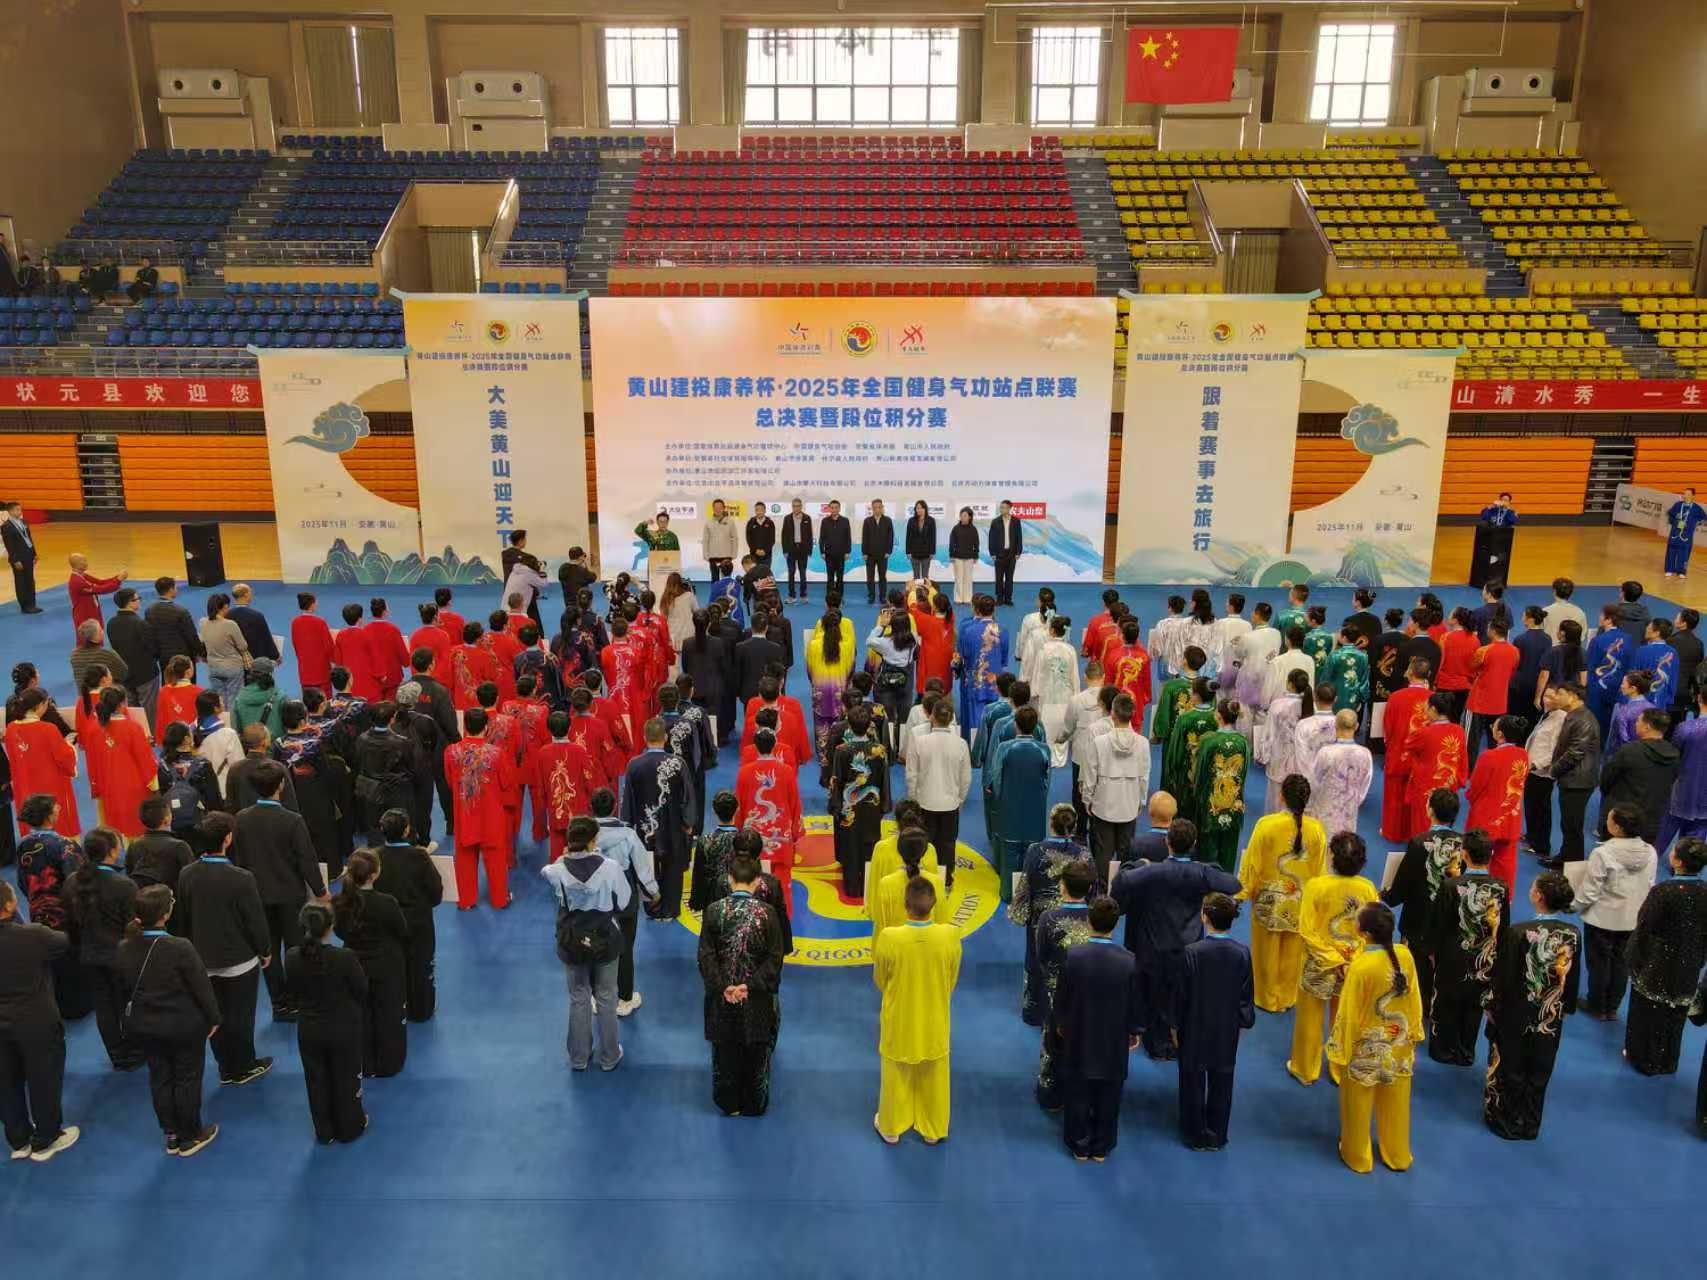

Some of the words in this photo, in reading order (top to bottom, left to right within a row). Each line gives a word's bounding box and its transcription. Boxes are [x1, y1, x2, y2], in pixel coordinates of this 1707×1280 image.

[16, 382, 251, 403] 状元县欢迎您
[627, 376, 1078, 398] 黄山建投康养杯·2025年全国健身气功站点联赛
[1456, 385, 1594, 405] 山清水秀
[1643, 385, 1701, 405] 一生
[755, 406, 948, 428] 总决赛暨段位积分赛
[1192, 386, 1221, 551] 跟着赛事去旅行
[806, 948, 872, 961] QIGO
